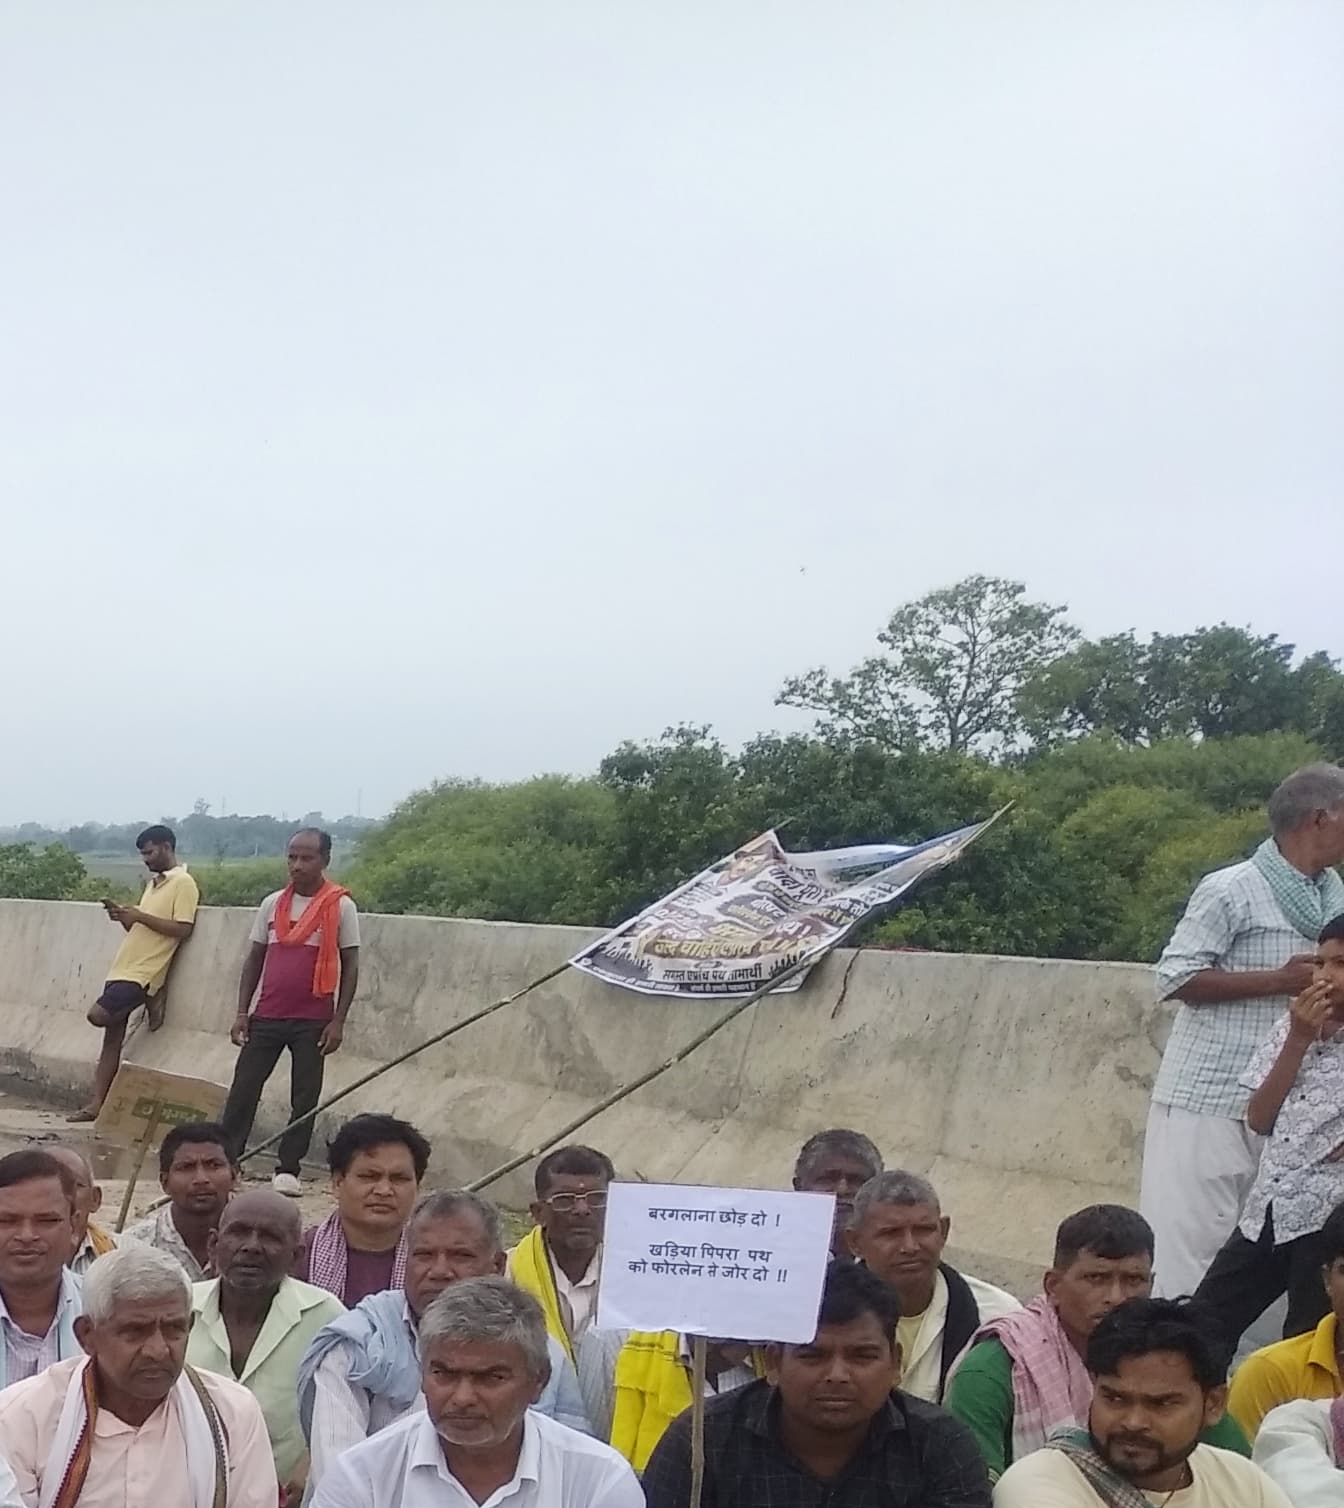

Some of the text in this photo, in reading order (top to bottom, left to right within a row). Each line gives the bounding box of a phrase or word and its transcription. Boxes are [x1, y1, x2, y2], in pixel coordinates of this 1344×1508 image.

[648, 1206, 716, 1223] बरगलाना
[719, 1208, 747, 1227] छोड़
[751, 1210, 768, 1227] दो
[649, 1241, 773, 1263] खड़िया पिपरा पथ
[628, 1259, 647, 1274] को
[651, 1259, 704, 1277] फोरलेन
[721, 1263, 750, 1281] जोर
[752, 1265, 770, 1282] दो
